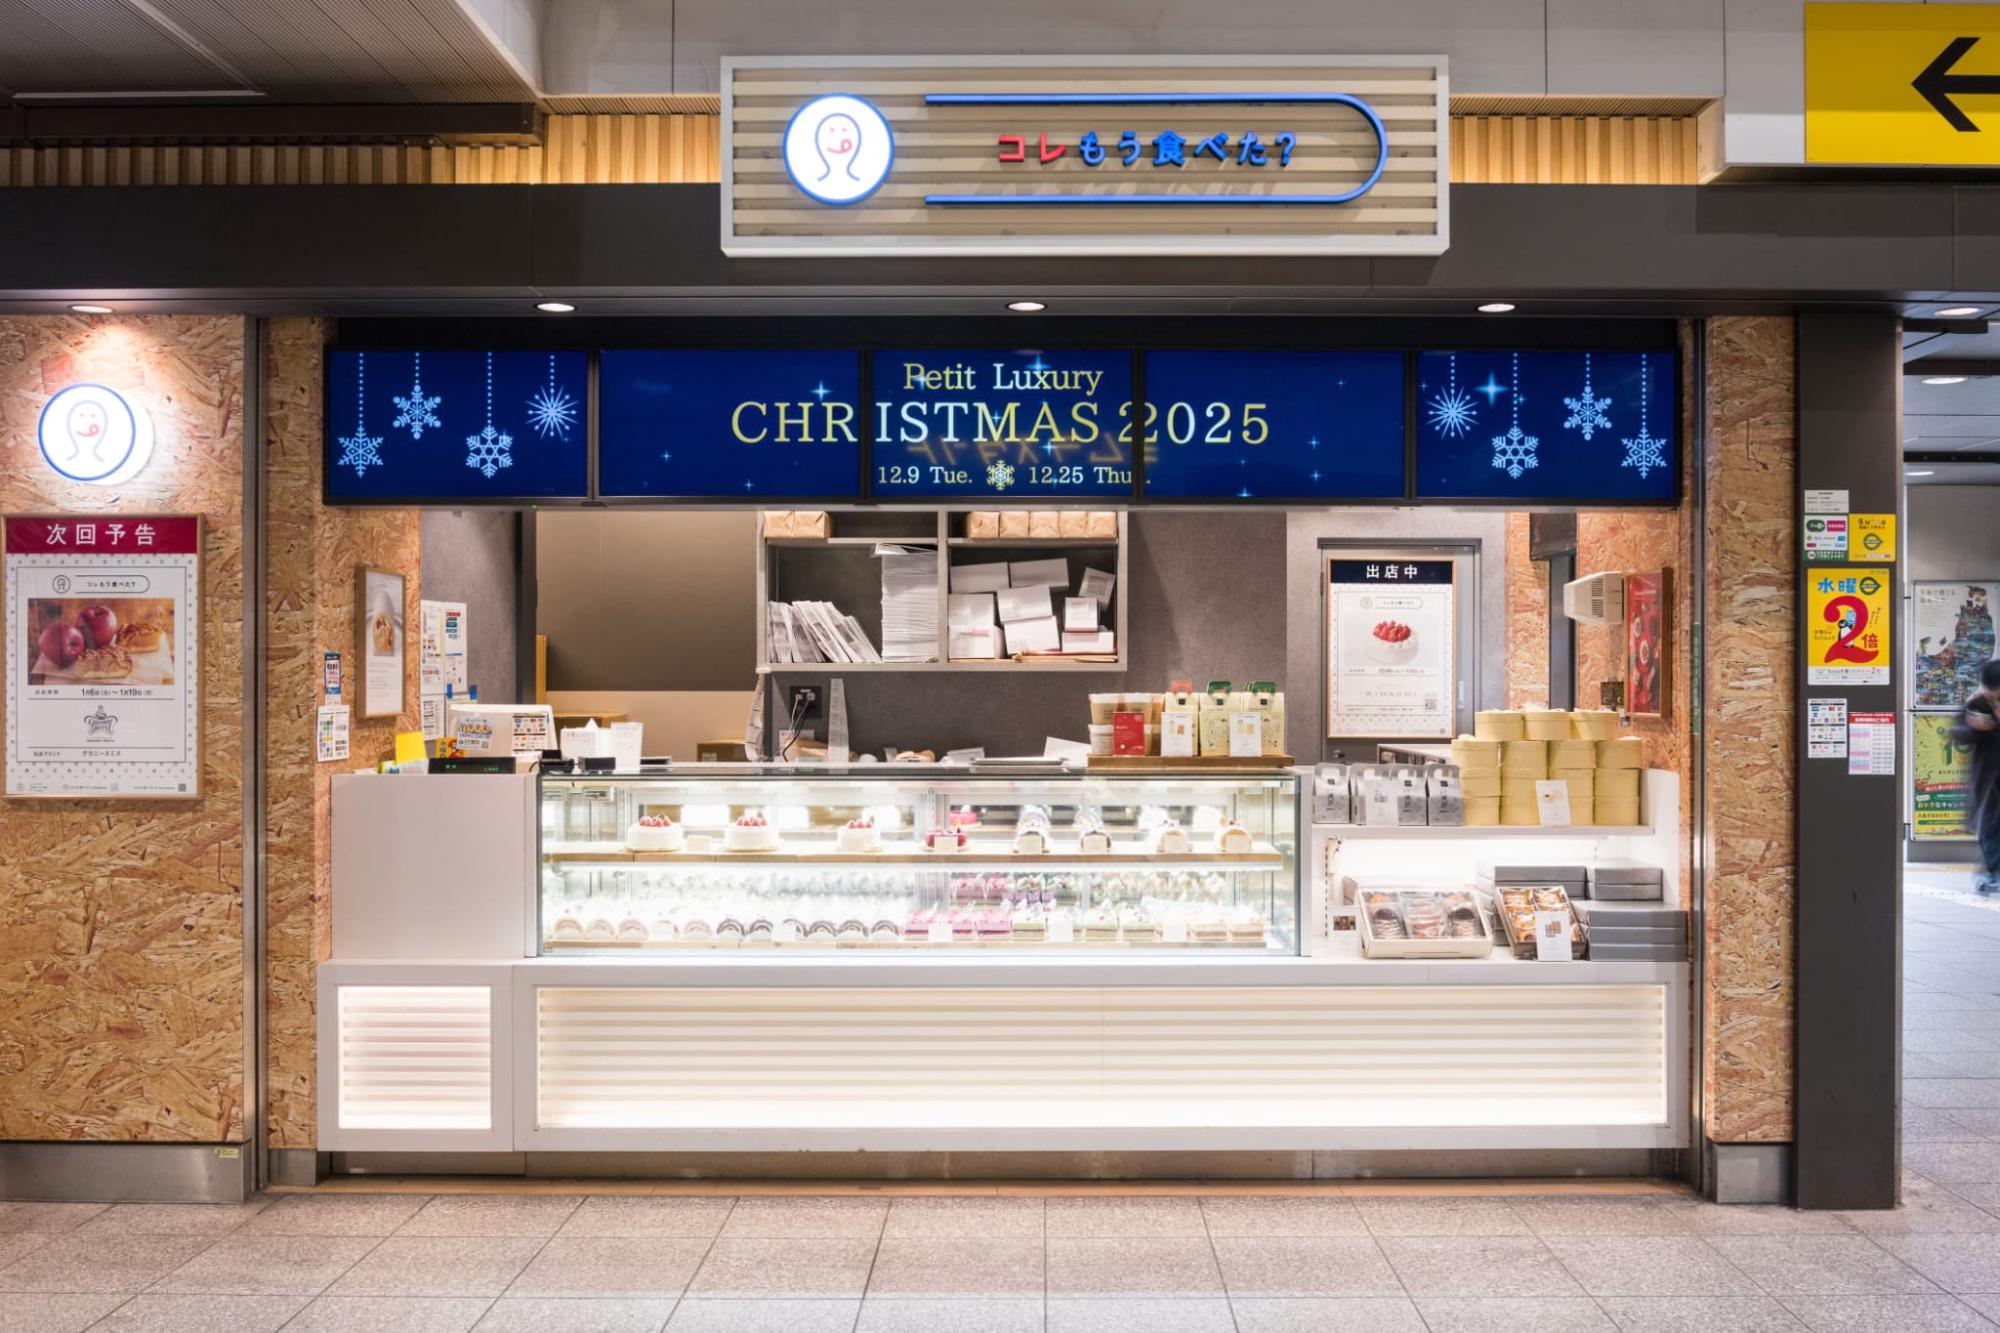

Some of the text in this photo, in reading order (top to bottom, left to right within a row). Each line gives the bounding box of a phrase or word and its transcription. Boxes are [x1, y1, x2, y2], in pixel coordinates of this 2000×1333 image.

[998, 130, 1297, 167] コレもう食べた？
[903, 363, 1103, 395] Petit Luxury
[732, 401, 1269, 445] CHRISTMAS 2025
[878, 466, 919, 485] 12.9
[929, 466, 973, 485] Tue.
[1028, 466, 1084, 485] 12.25
[46, 523, 156, 546] 次回予告
[1366, 564, 1418, 579] 出店中
[1817, 577, 1857, 594] 水曜
